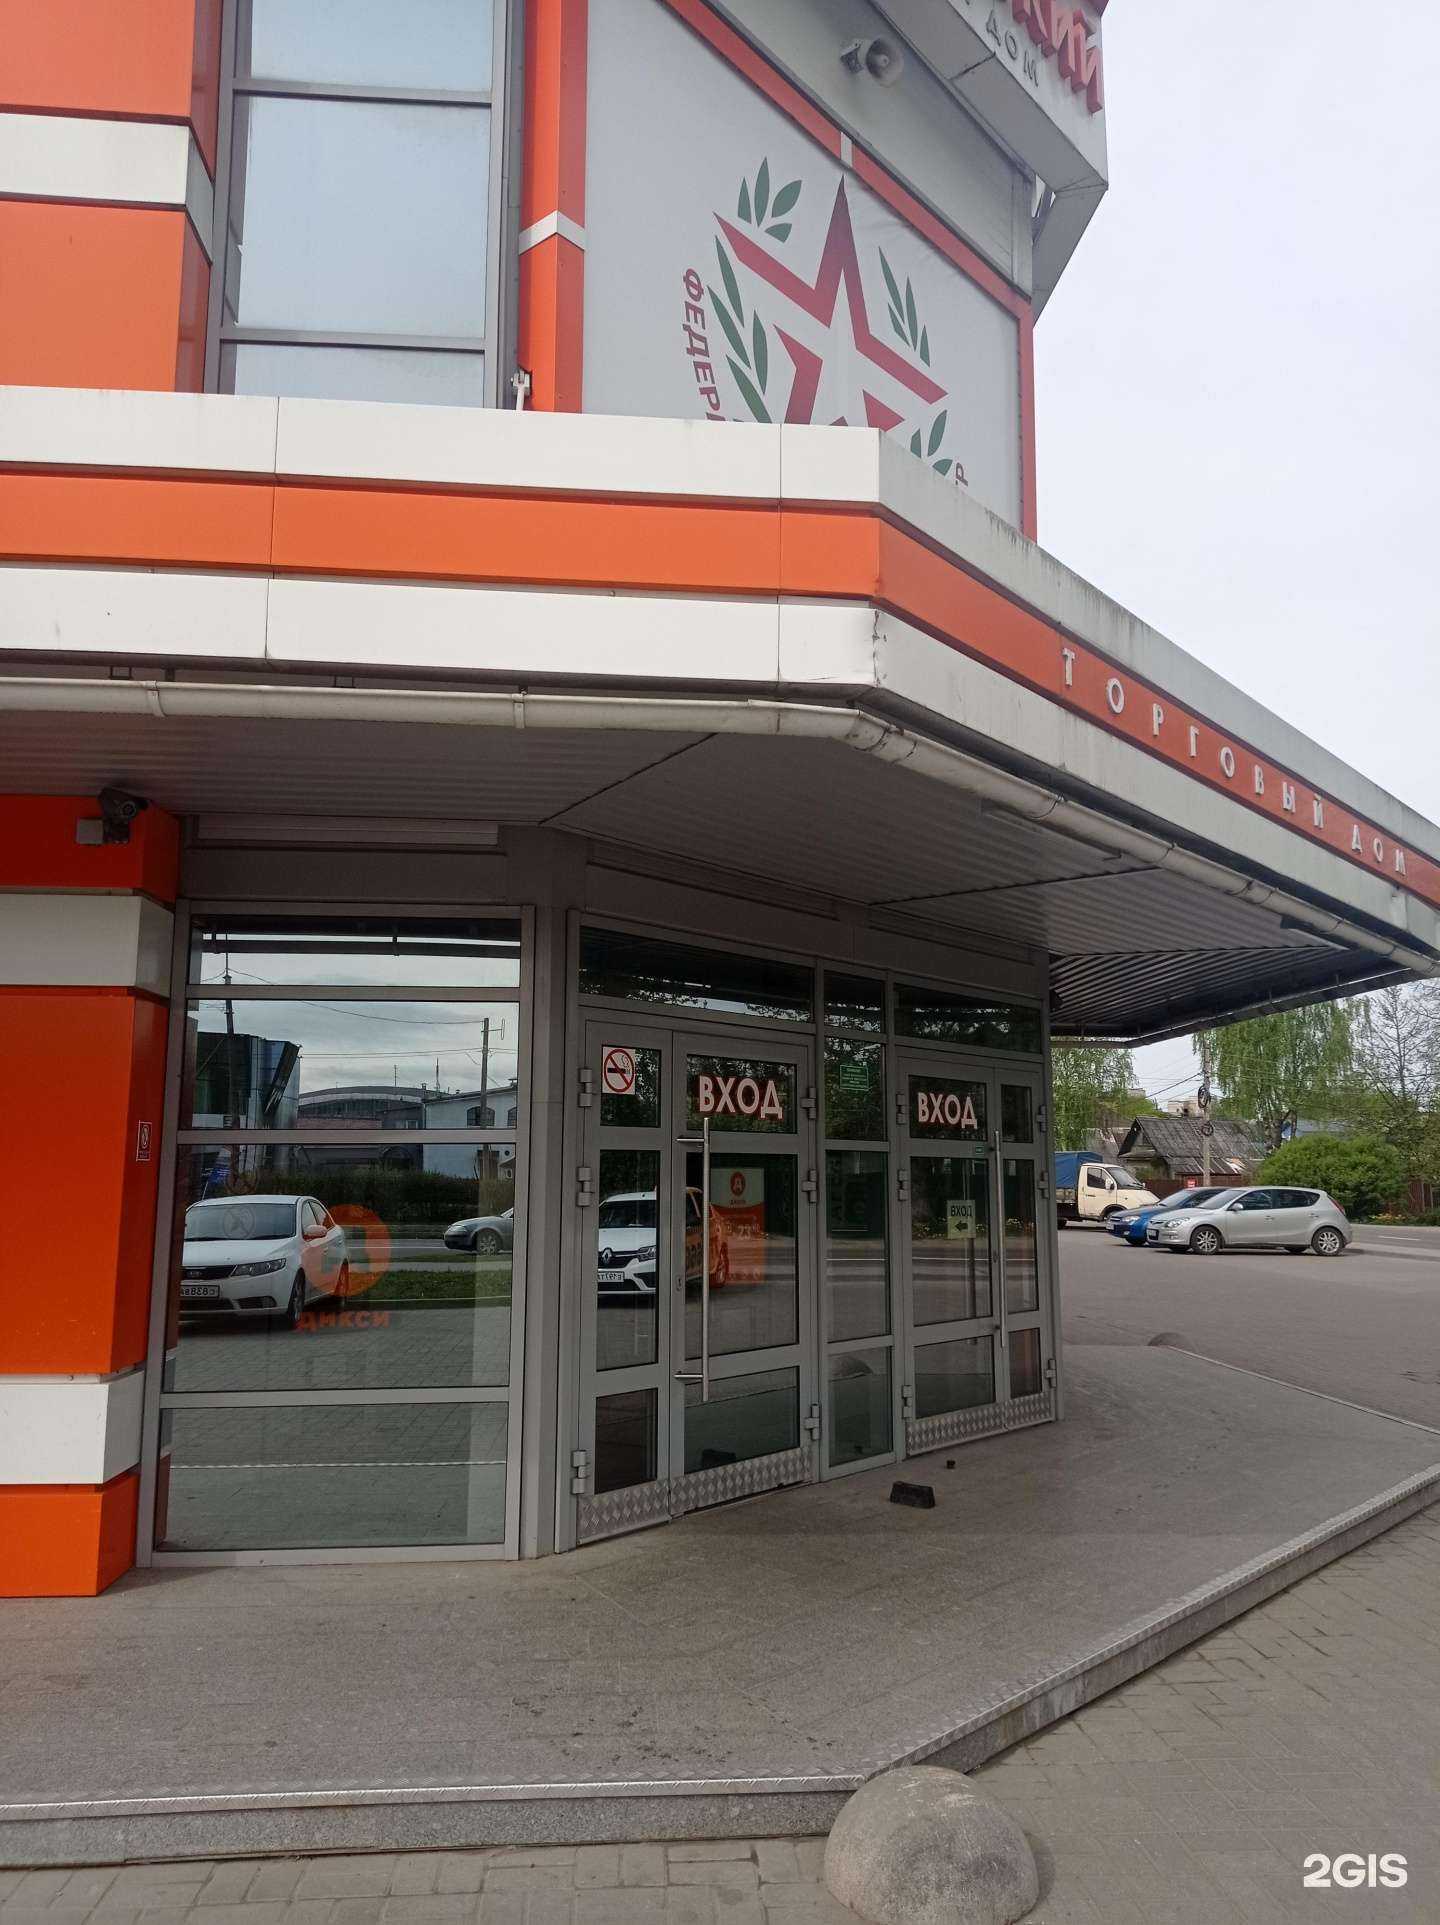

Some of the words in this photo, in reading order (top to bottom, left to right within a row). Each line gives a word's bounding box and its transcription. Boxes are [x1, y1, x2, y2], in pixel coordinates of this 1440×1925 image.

[1062, 647, 1325, 829] ТОРГОВЫЙ
[1352, 824, 1406, 876] ДОМ
[699, 1075, 783, 1119] ВХОД
[918, 1092, 978, 1129] ВХОД
